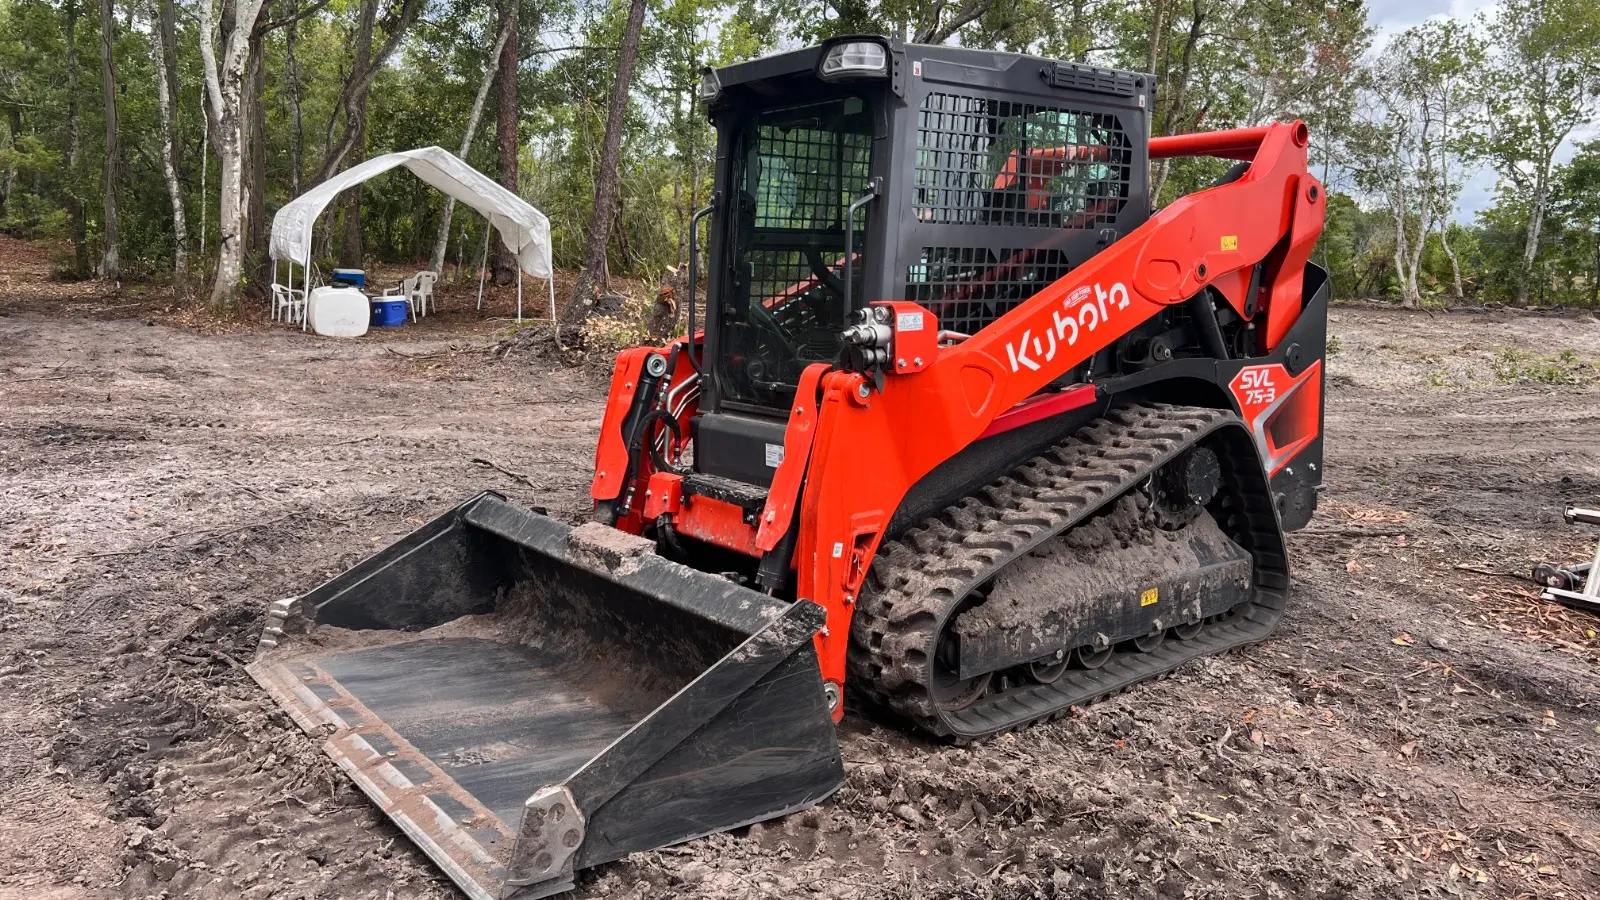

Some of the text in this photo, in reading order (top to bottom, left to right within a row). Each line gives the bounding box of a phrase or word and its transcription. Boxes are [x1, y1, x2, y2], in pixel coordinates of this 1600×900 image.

[1006, 282, 1130, 373] Kubota
[1239, 369, 1275, 389] SVL
[1245, 387, 1276, 405] 75-3
